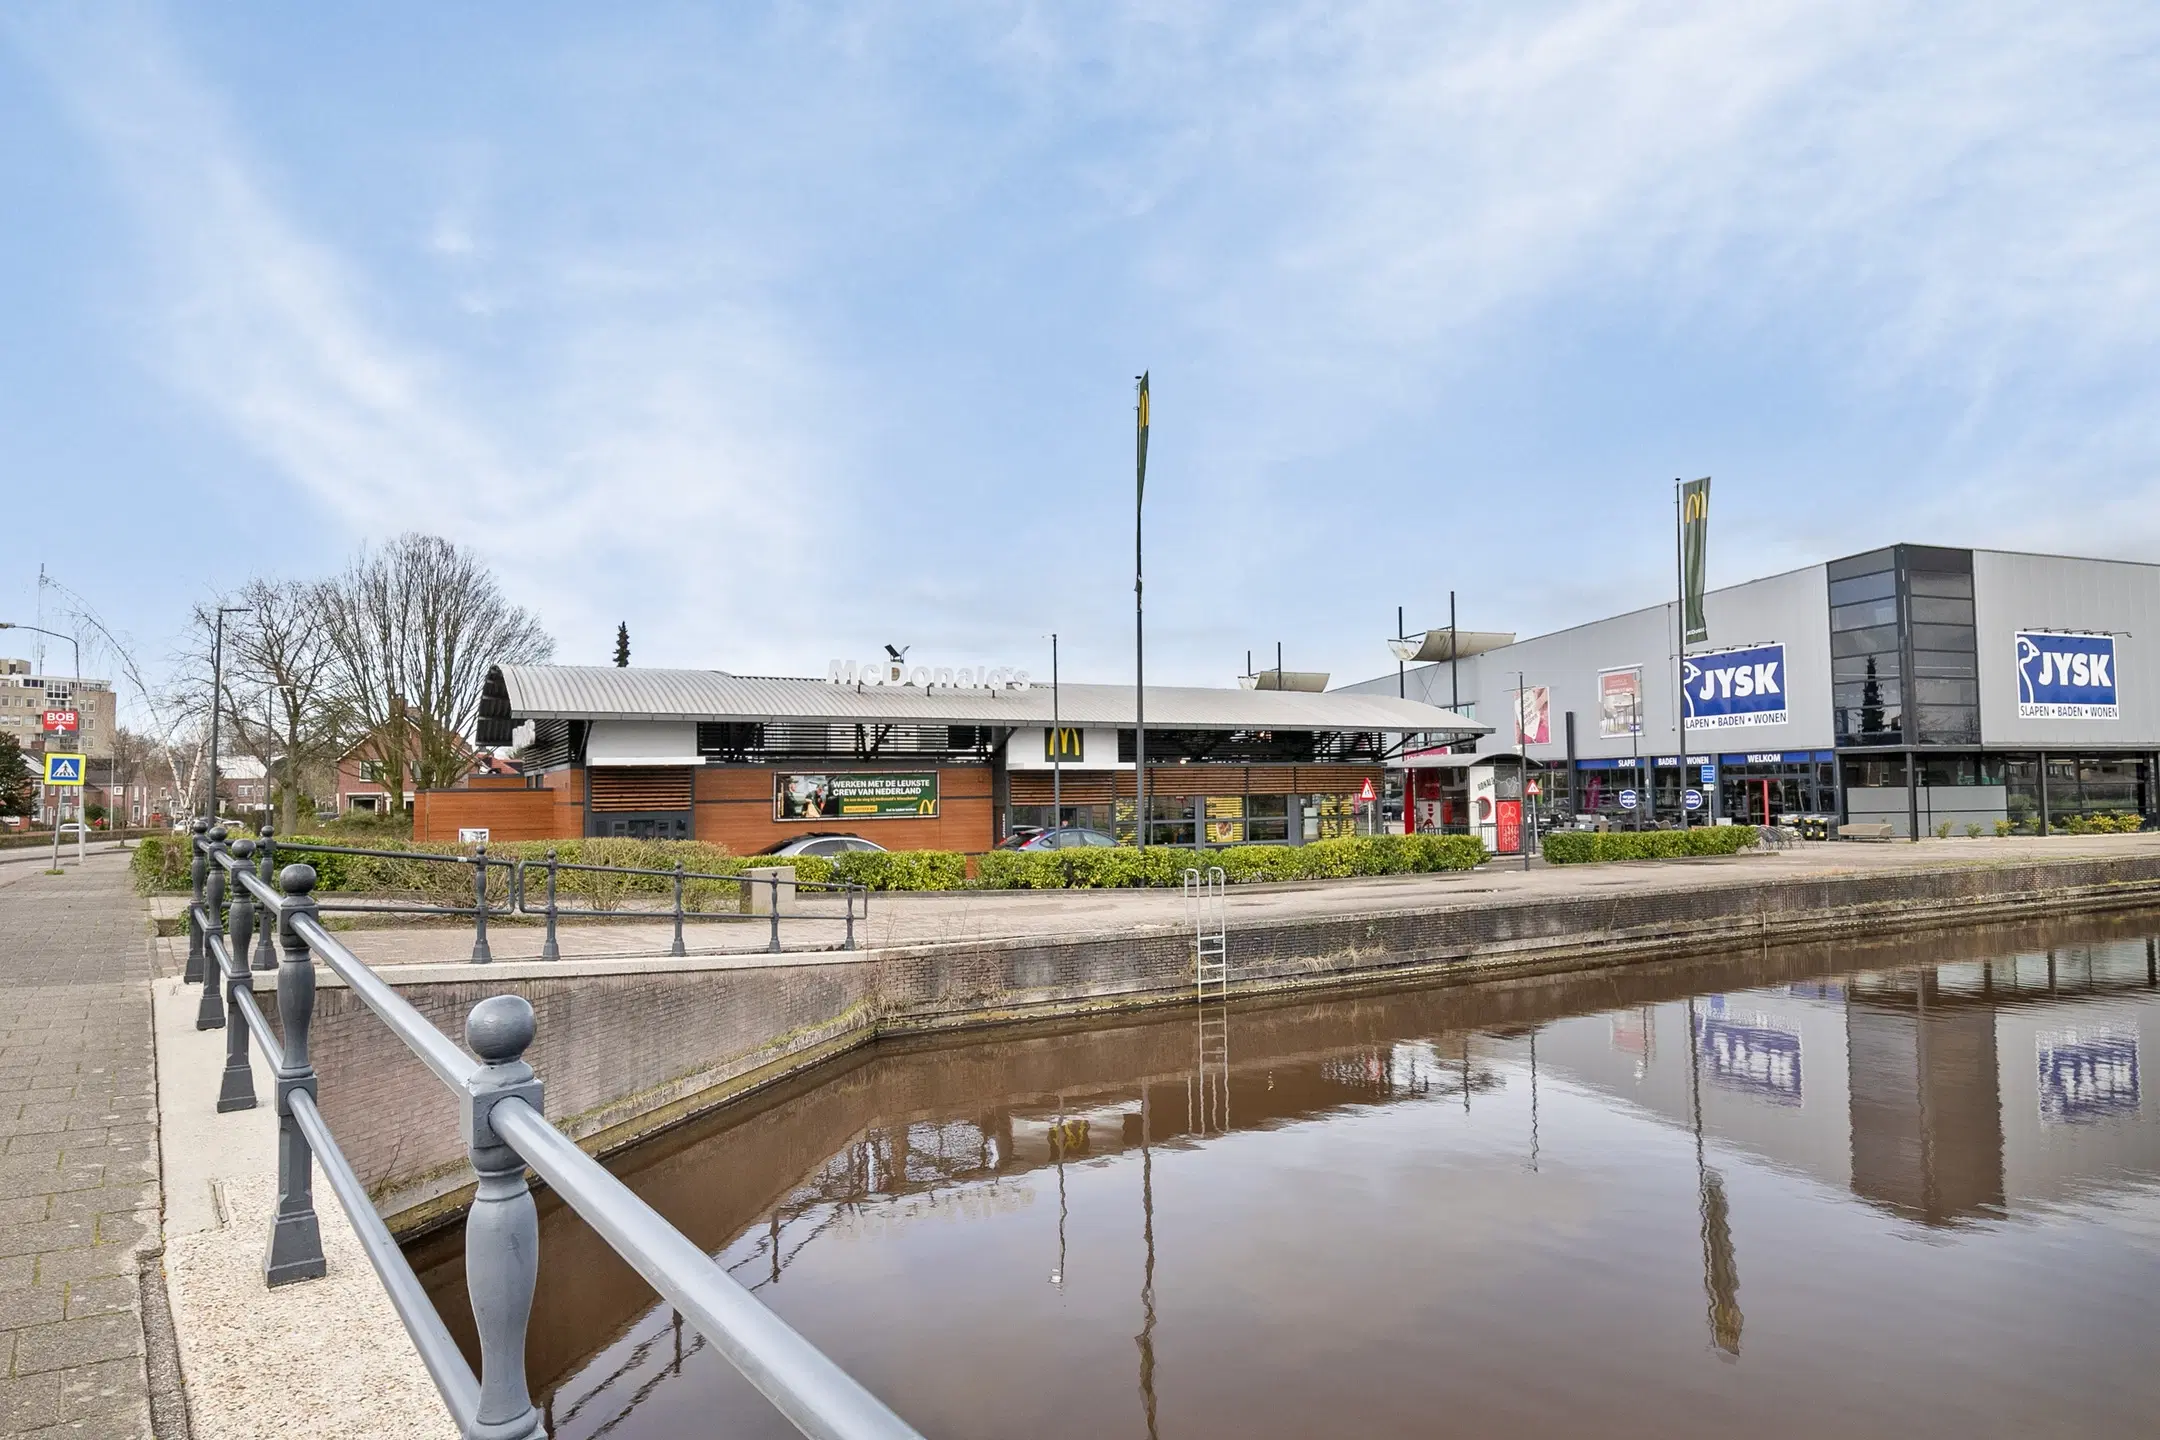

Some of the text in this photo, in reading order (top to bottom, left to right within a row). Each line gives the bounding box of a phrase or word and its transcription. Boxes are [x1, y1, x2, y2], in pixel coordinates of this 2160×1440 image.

[2038, 652, 2112, 687] JYSK
[826, 659, 1031, 692] McDonald's
[1699, 661, 1780, 701] JYSK
[47, 712, 74, 721] BOB
[2020, 705, 2118, 718] SLAPEN BADEN WONEN
[1685, 712, 1787, 729] LAPEN BADEN WONEN
[1658, 757, 1677, 766] BADEN
[1686, 755, 1709, 765] WONEN
[1747, 753, 1781, 763] WELKOM
[833, 780, 866, 788] WERKEN
[885, 779, 896, 787] DE
[897, 779, 930, 787] LEUKSTE
[832, 787, 921, 796] CREW VAN NEDERLAND
